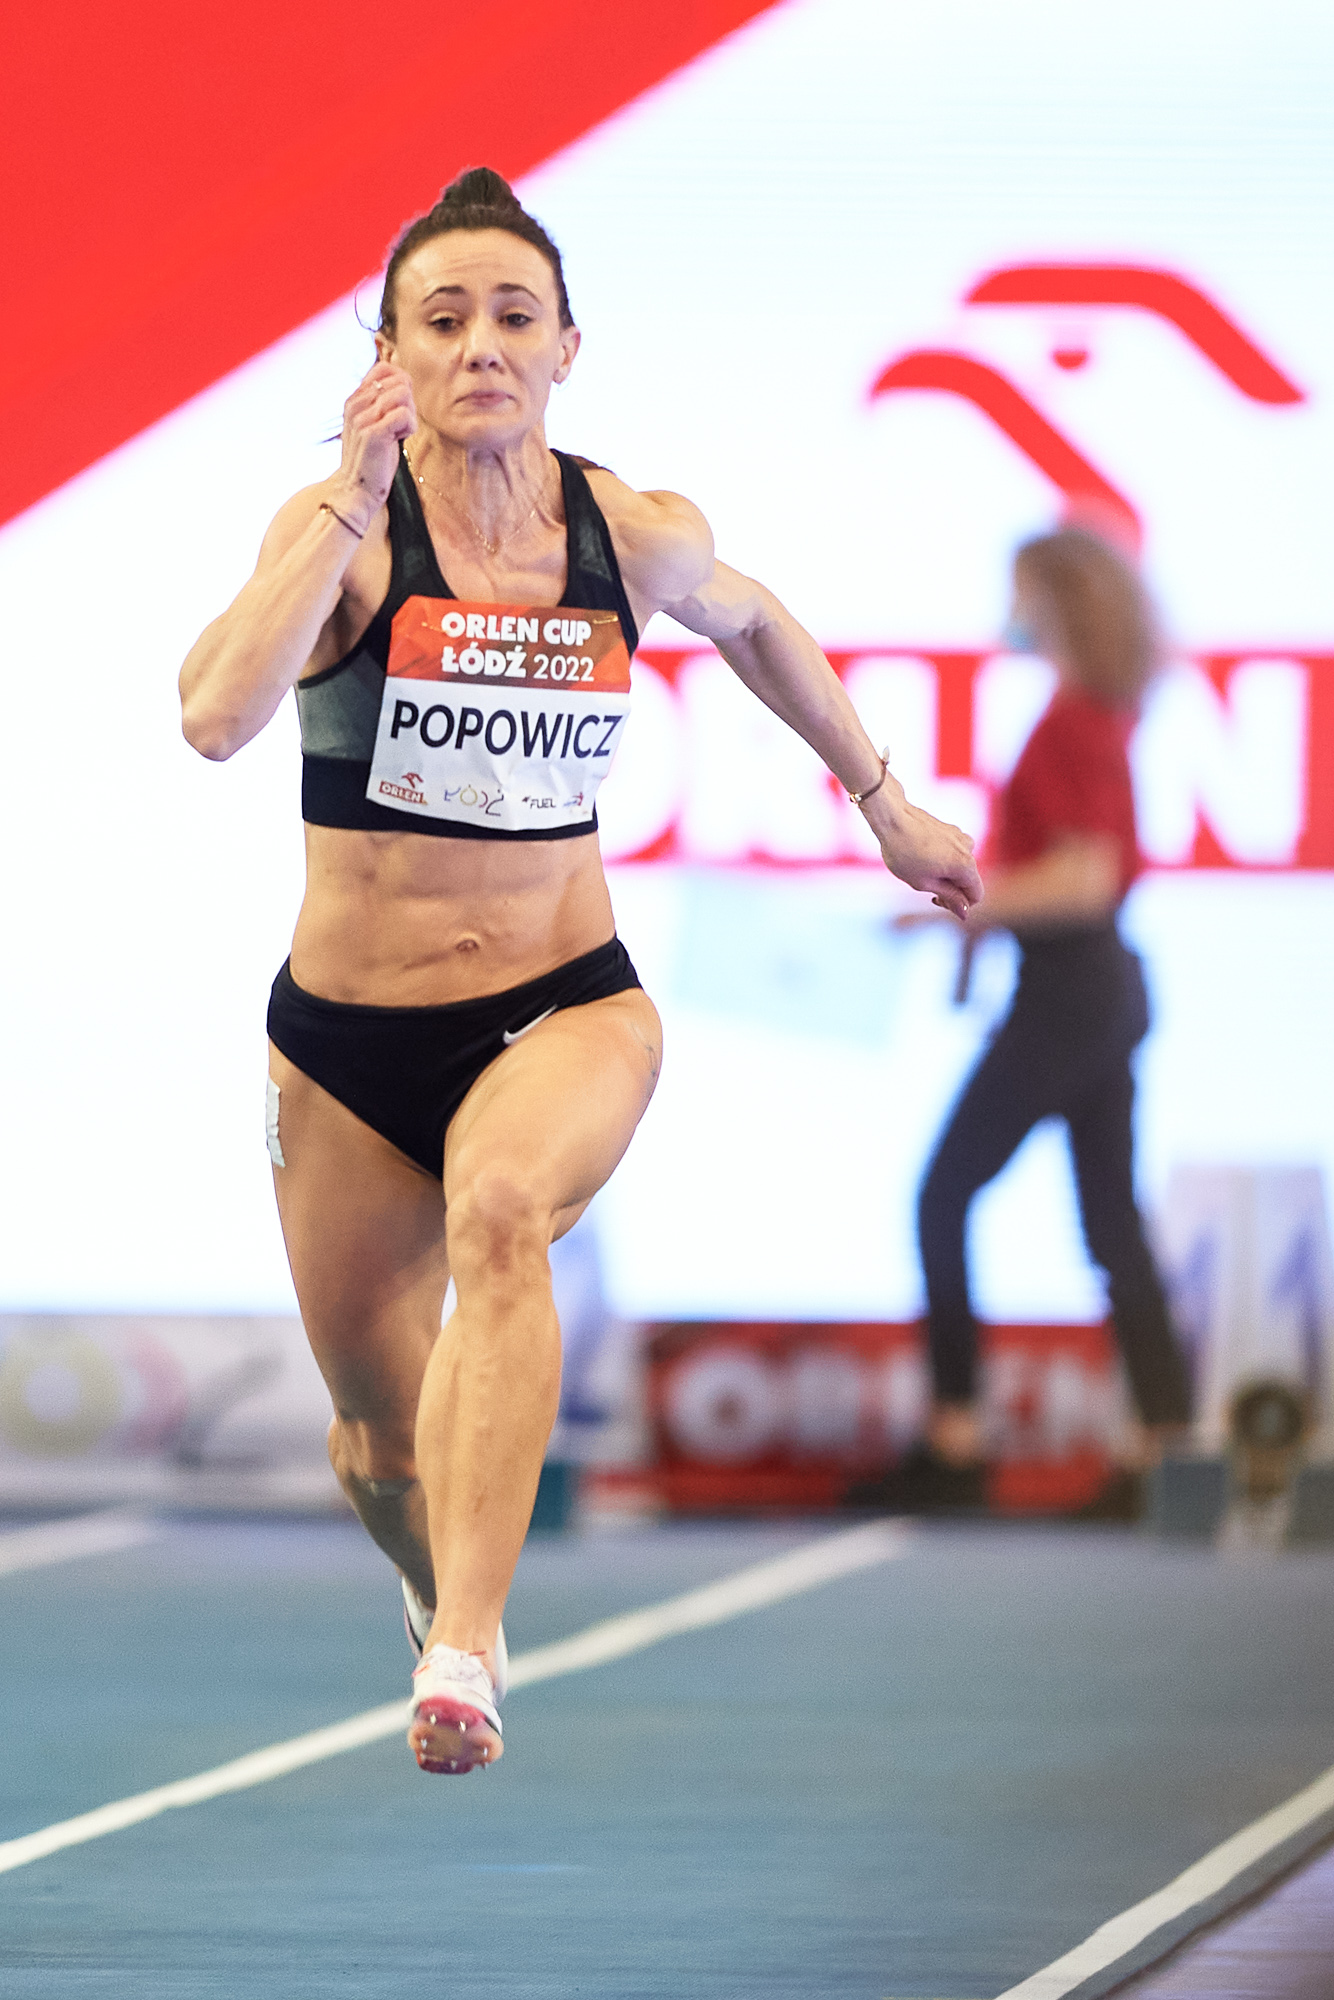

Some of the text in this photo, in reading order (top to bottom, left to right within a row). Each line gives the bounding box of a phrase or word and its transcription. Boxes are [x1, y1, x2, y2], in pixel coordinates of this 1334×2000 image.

[441, 612, 592, 646] ORLEN CUP
[441, 641, 594, 682] ŁÓDŹ 2022
[390, 699, 623, 759] POPOWICZ
[381, 783, 421, 803] ORLEN
